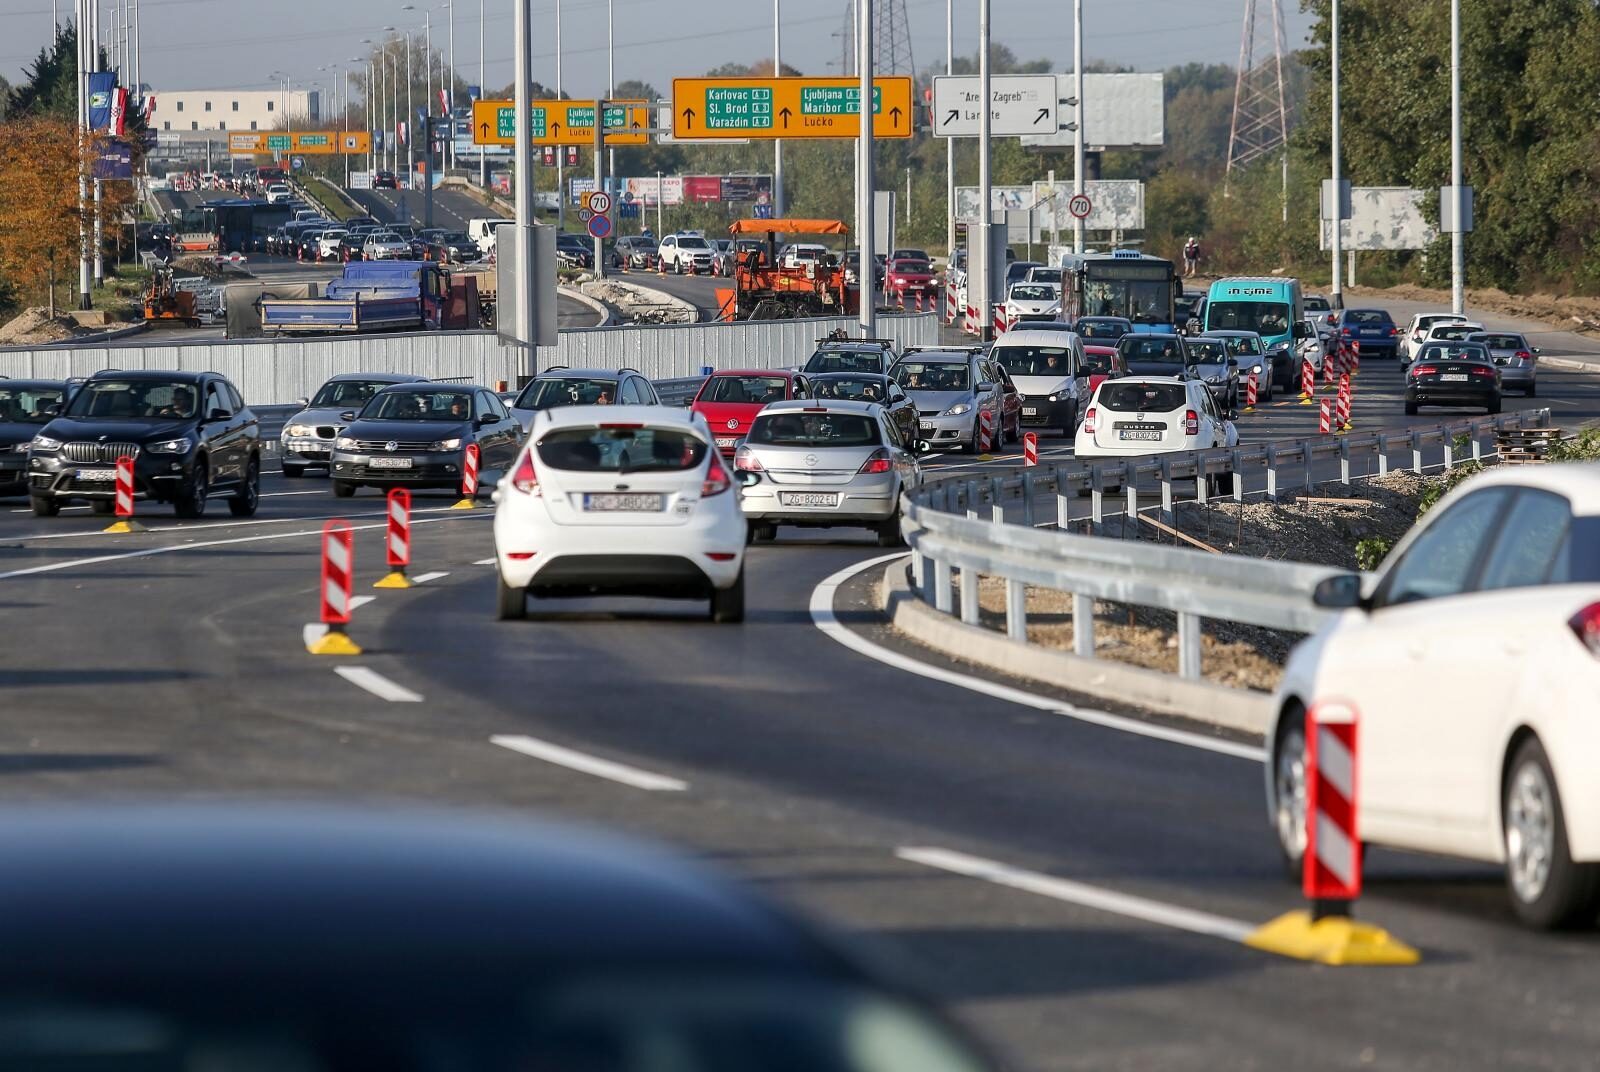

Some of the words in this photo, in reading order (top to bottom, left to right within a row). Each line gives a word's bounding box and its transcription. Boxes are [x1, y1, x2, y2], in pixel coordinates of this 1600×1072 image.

[709, 90, 748, 100] Karlovac
[804, 89, 843, 101] Ljubljana
[709, 103, 721, 113] Sl.
[726, 103, 748, 113] Brod
[804, 102, 842, 112] Maribor
[569, 108, 594, 118] Ljubljan
[709, 116, 748, 127] Varaždin
[804, 116, 833, 126] Lučko
[593, 197, 607, 208] 70
[1075, 201, 1088, 212] 70
[790, 494, 800, 504] ZG
